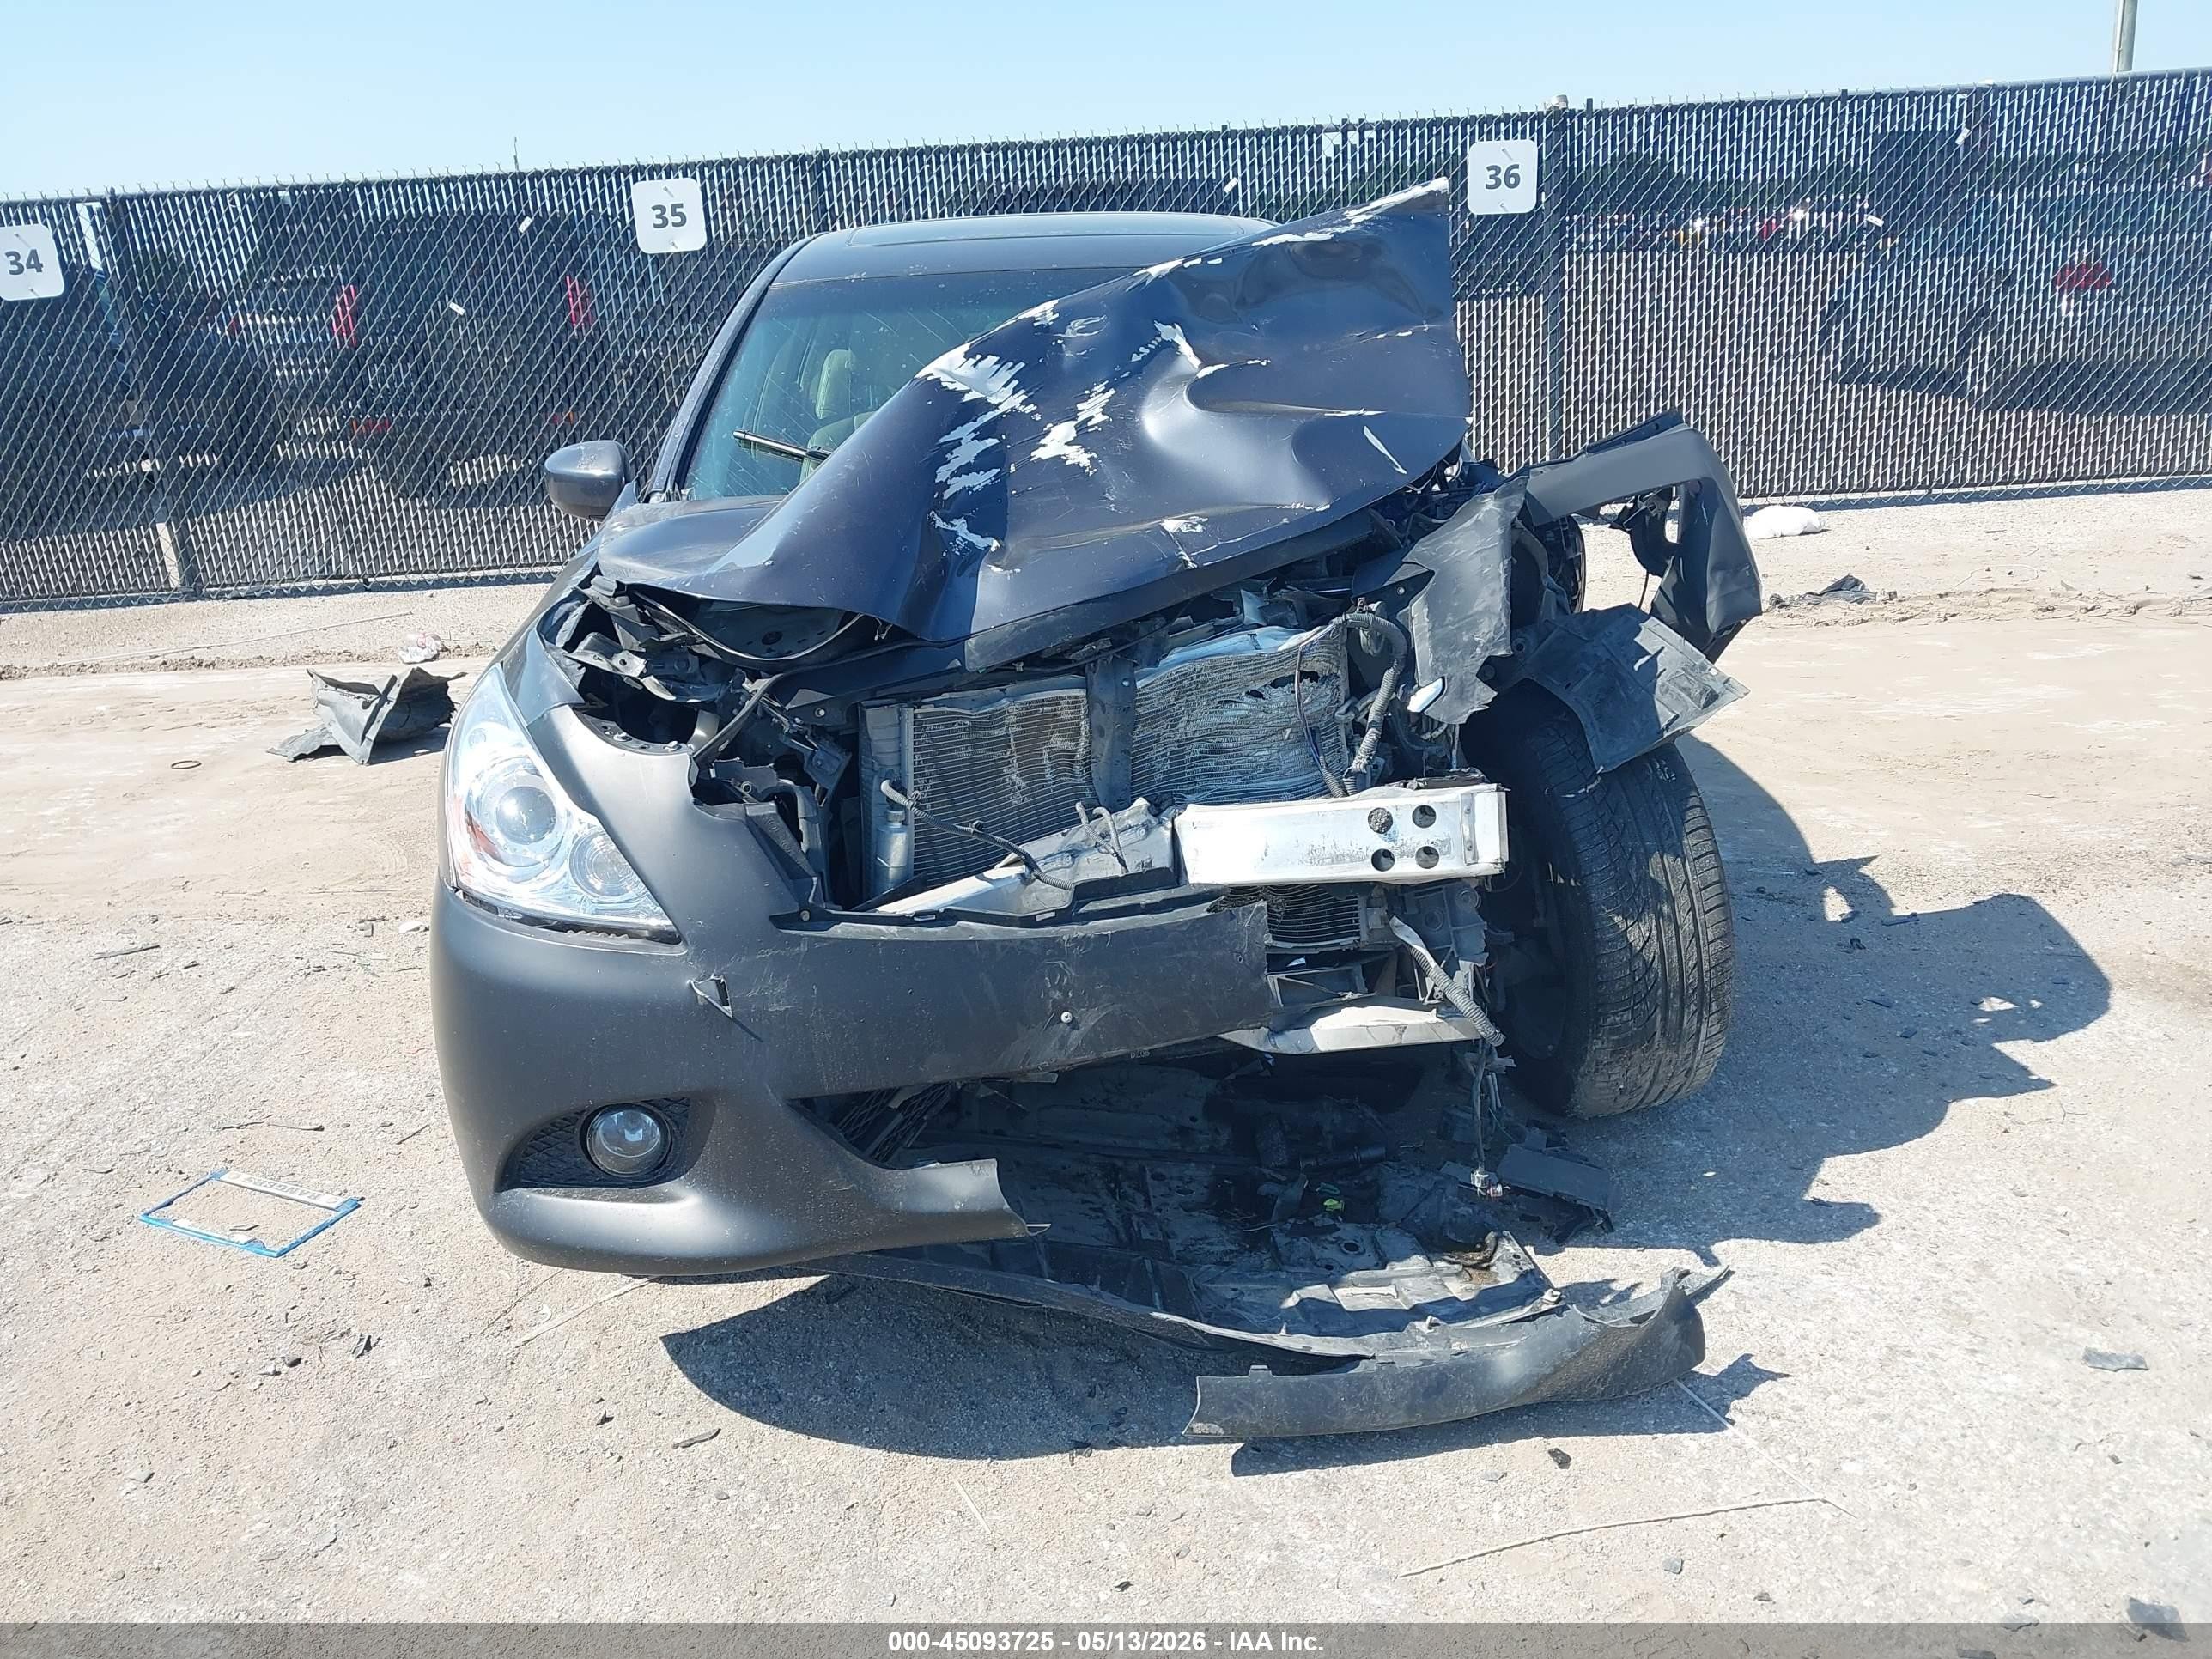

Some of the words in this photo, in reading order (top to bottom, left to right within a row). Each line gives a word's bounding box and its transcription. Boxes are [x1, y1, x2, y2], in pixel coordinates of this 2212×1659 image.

[1485, 163, 1521, 190] 36
[651, 203, 687, 229] 35
[4, 248, 44, 276] 34
